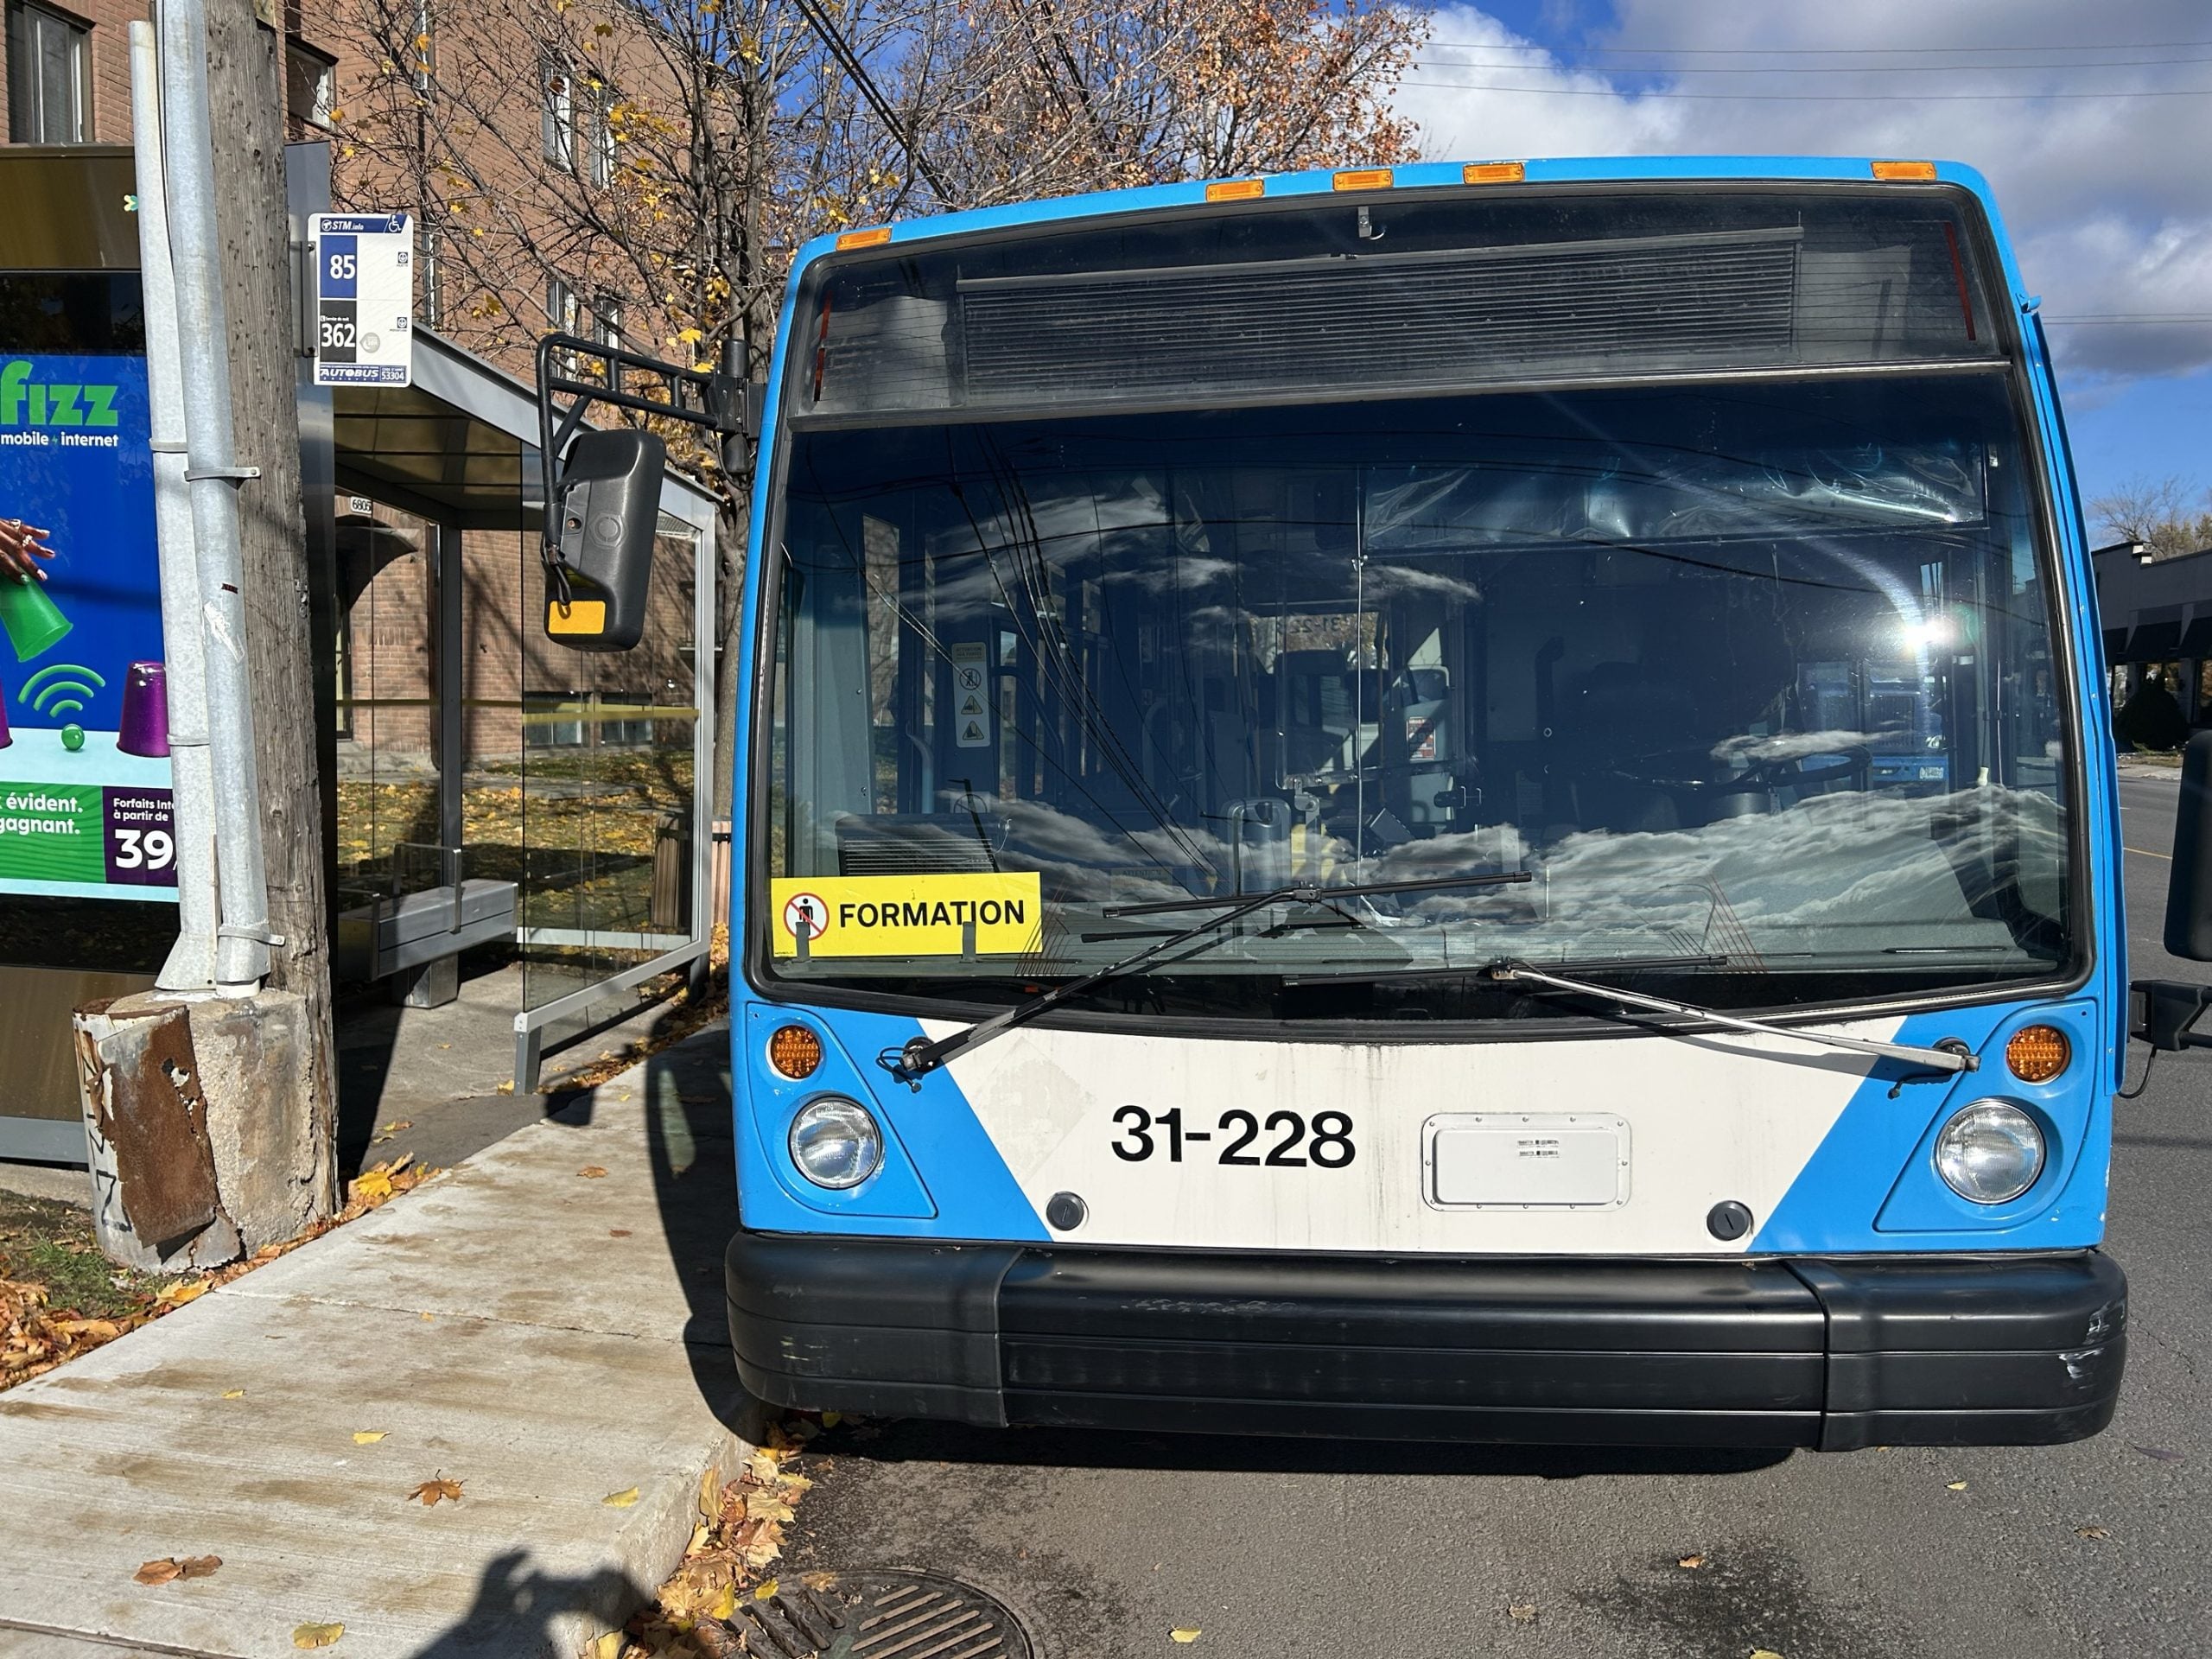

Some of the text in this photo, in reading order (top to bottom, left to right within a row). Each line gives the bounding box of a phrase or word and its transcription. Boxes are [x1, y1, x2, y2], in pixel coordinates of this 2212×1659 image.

[330, 254, 356, 280] 85
[321, 323, 356, 347] 362
[320, 368, 379, 378] AUTOBUS
[381, 371, 405, 380] 53304
[1, 360, 118, 426] fizz
[1, 432, 118, 447] mobile internet
[353, 499, 372, 512] 6805
[6, 791, 83, 813] évident.
[113, 798, 175, 810] Forfaits Int
[113, 810, 168, 821] à partir de
[839, 899, 1025, 928] FORMATION
[1111, 1104, 1356, 1169] 31-228
